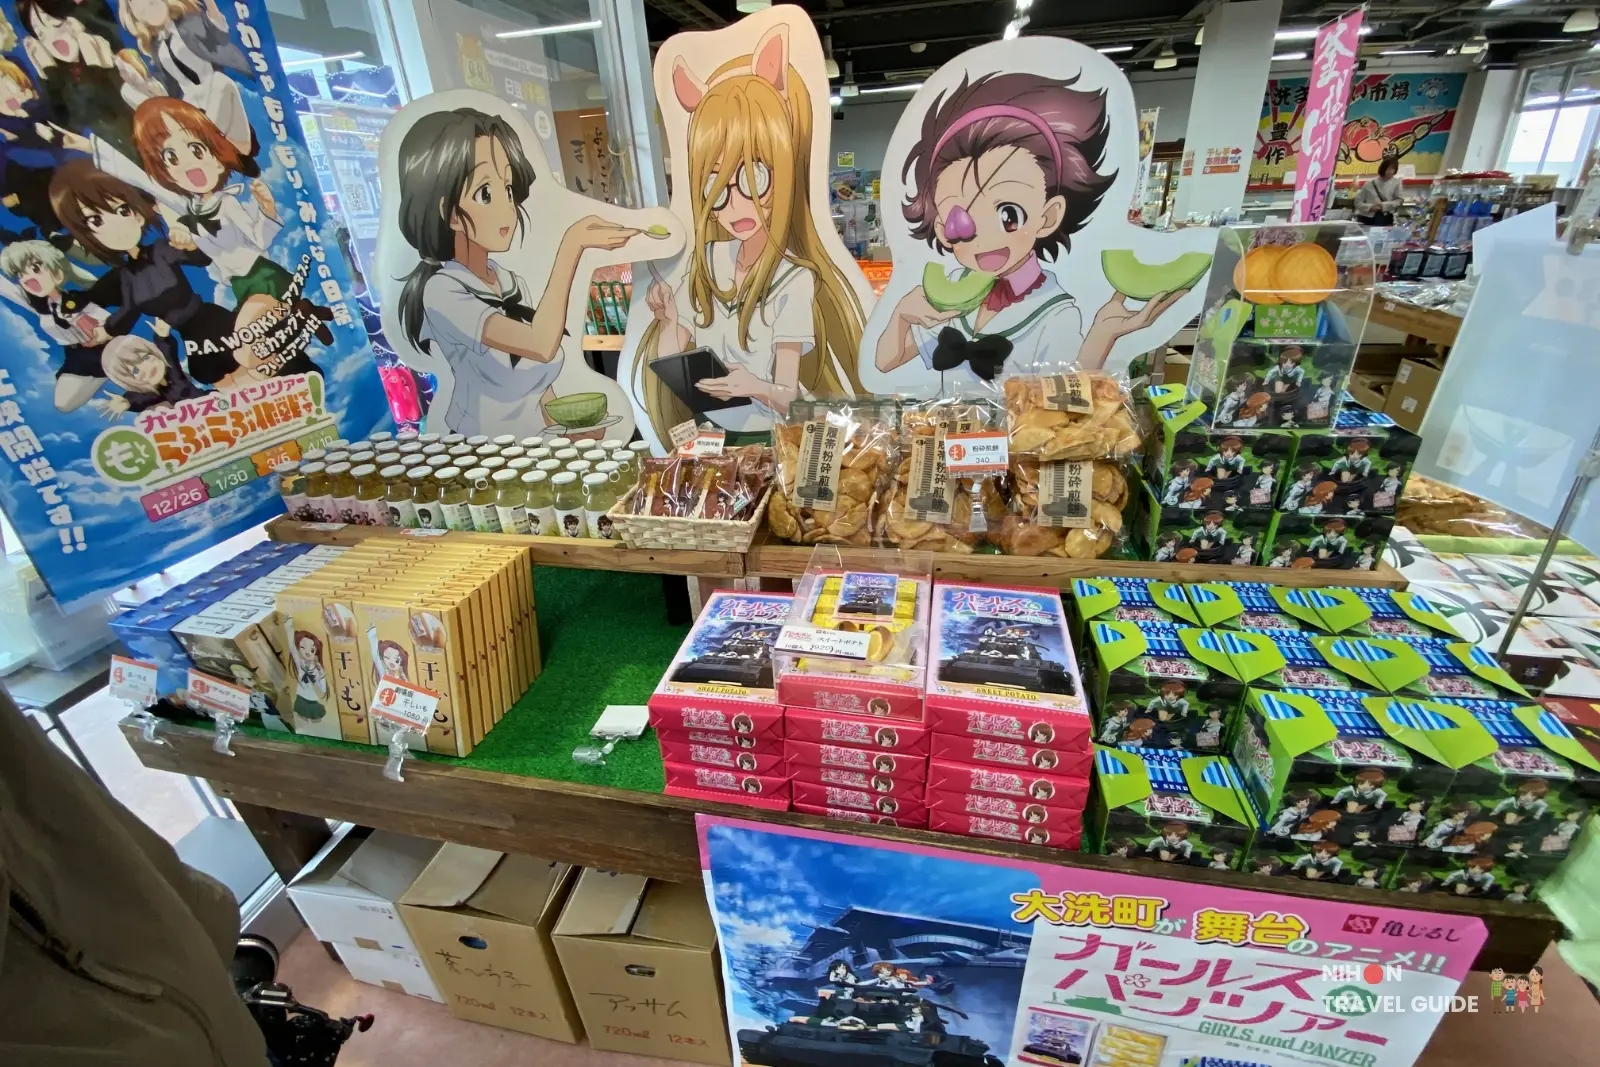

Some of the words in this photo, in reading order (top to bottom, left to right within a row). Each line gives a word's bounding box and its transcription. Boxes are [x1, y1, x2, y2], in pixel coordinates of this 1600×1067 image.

[103, 440, 150, 475] もっと
[817, 426, 839, 499] 履帯粉砕煎餅
[215, 471, 249, 492] 1/30
[1067, 460, 1082, 516] 粉砕煎餅
[151, 490, 202, 516] 12/26
[818, 636, 865, 647] スイートポテト
[334, 650, 362, 711] 干しいも
[976, 687, 1004, 697] SWEET
[1005, 690, 1037, 700] POTATO
[403, 698, 428, 713] 干しいも
[1011, 889, 1187, 935] 大洗町が
[1193, 909, 1447, 974] 舞台のアニメ!!
[1381, 918, 1465, 942] 亀じるし
[1054, 933, 1356, 1002] ガールズ
[454, 993, 497, 1011] 720ml
[588, 992, 690, 1020] アッサム
[1054, 968, 1389, 1047] パンツァー
[601, 1024, 651, 1039] 720ml
[1199, 1020, 1254, 1043] GIRLS
[1258, 1032, 1297, 1050] und
[1299, 1039, 1378, 1067] PANZER
